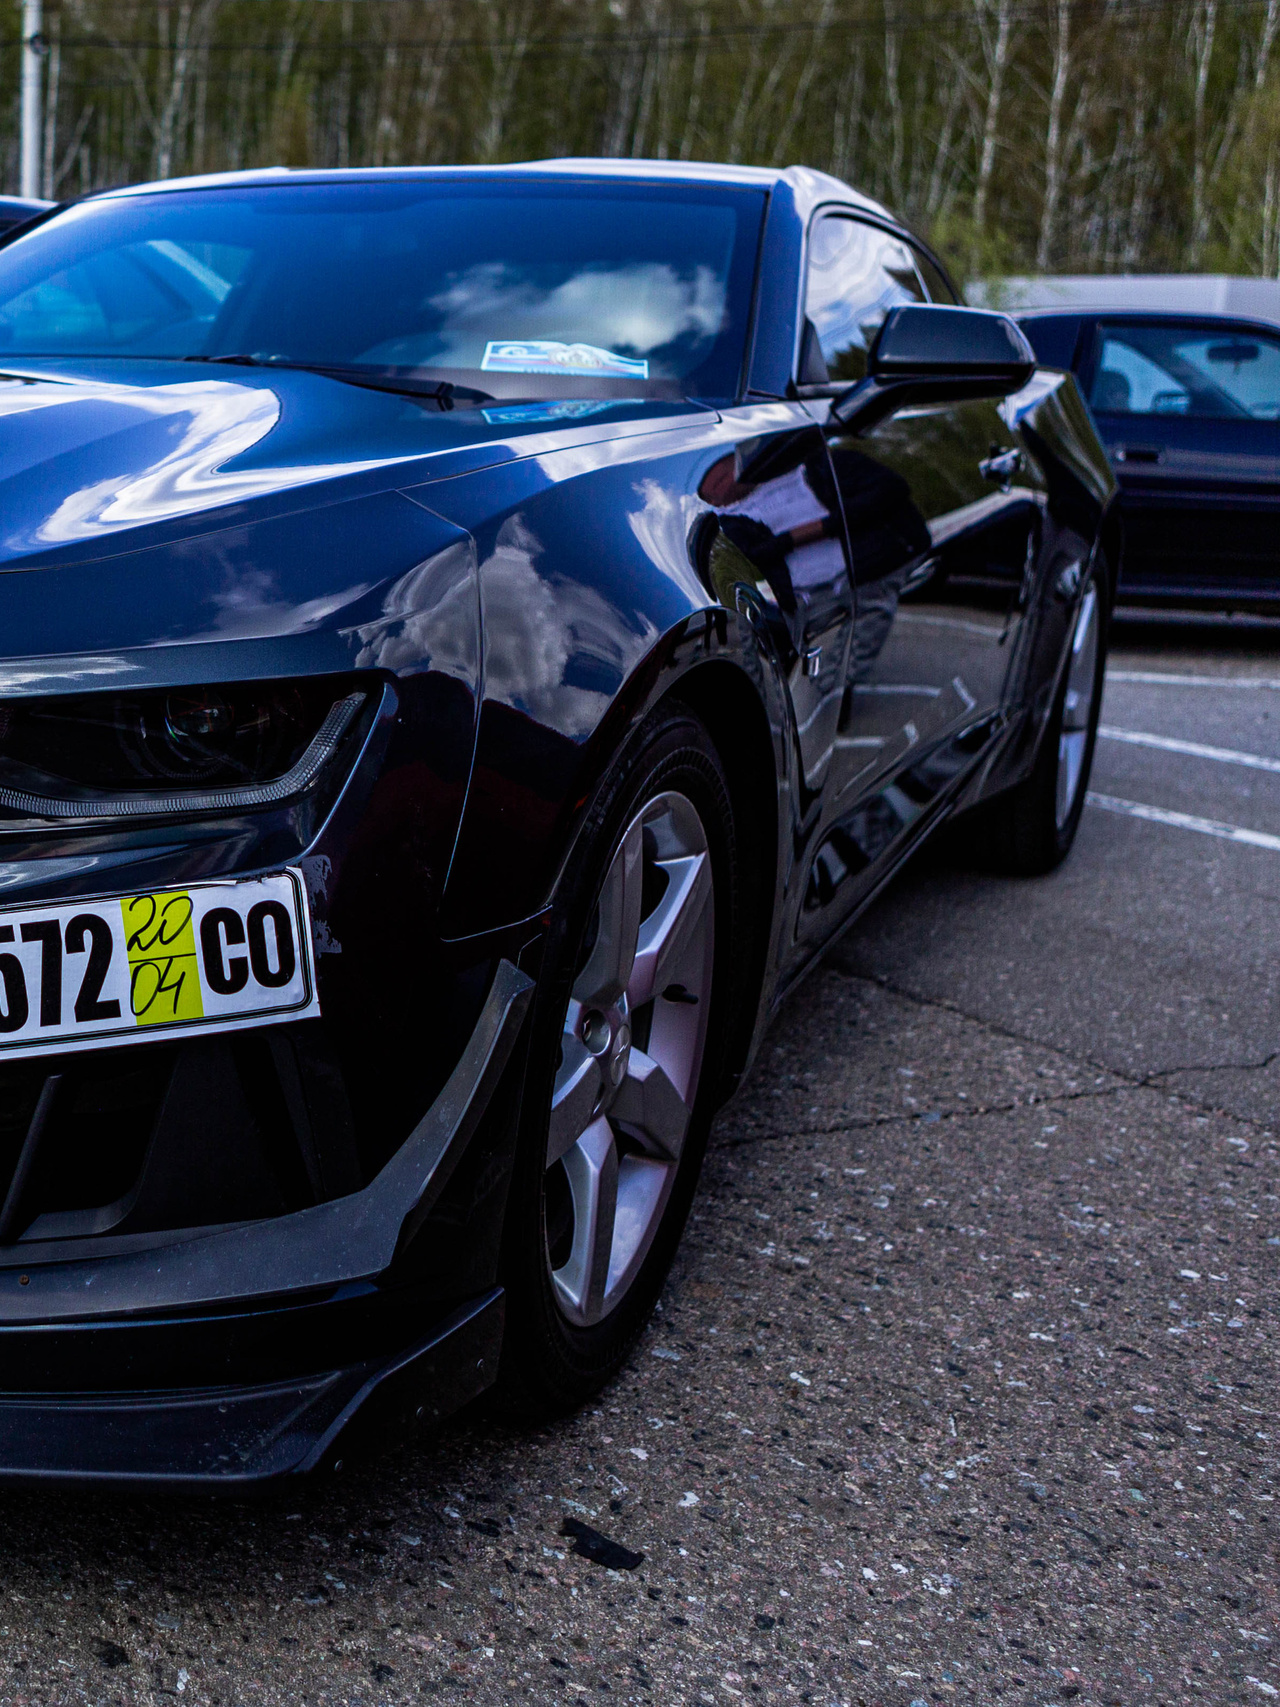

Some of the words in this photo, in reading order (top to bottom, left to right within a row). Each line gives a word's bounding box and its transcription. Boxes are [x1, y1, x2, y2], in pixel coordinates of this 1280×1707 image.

[127, 895, 194, 952] 20
[200, 900, 296, 995] CO
[130, 958, 186, 1016] 04
